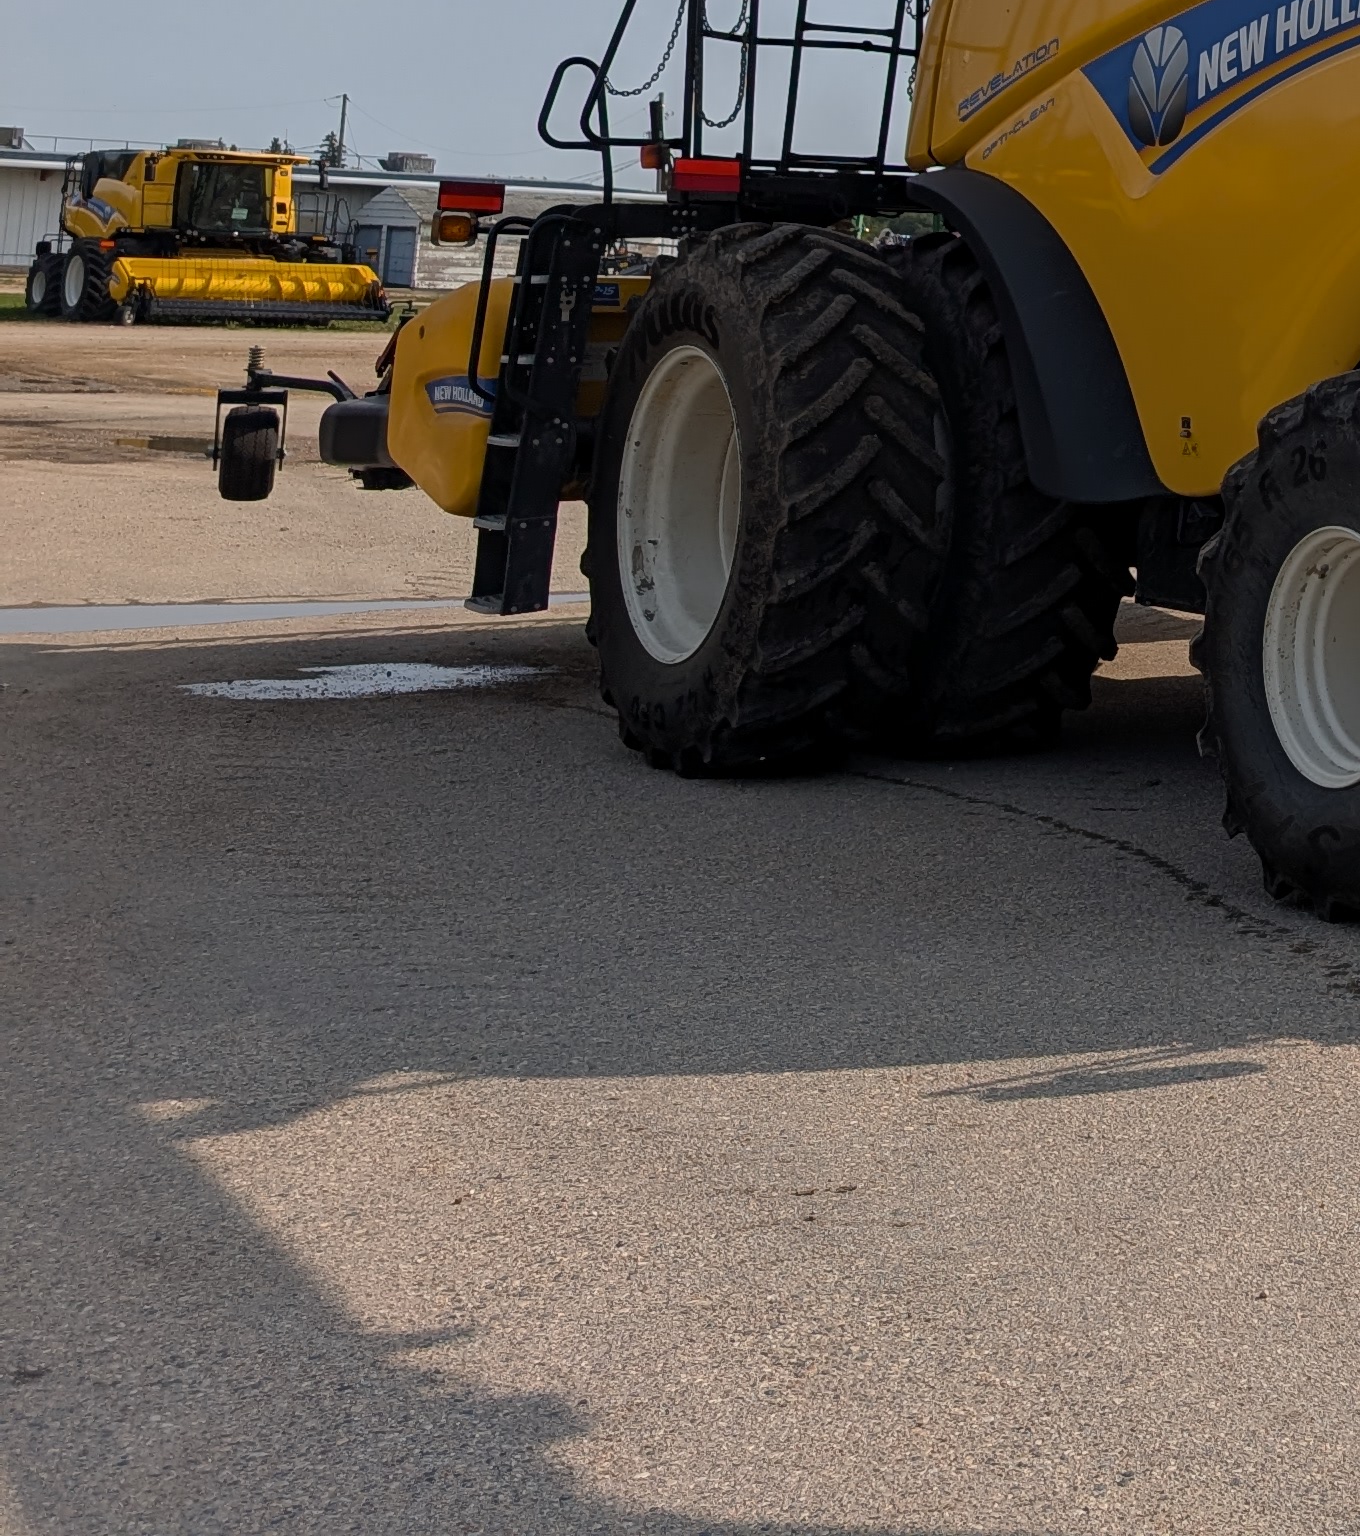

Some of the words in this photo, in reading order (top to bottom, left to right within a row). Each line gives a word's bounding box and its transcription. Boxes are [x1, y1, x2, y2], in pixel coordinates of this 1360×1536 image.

[1197, 13, 1269, 100] NEW
[434, 385, 452, 401] NEW
[452, 385, 485, 408] HOLLAND
